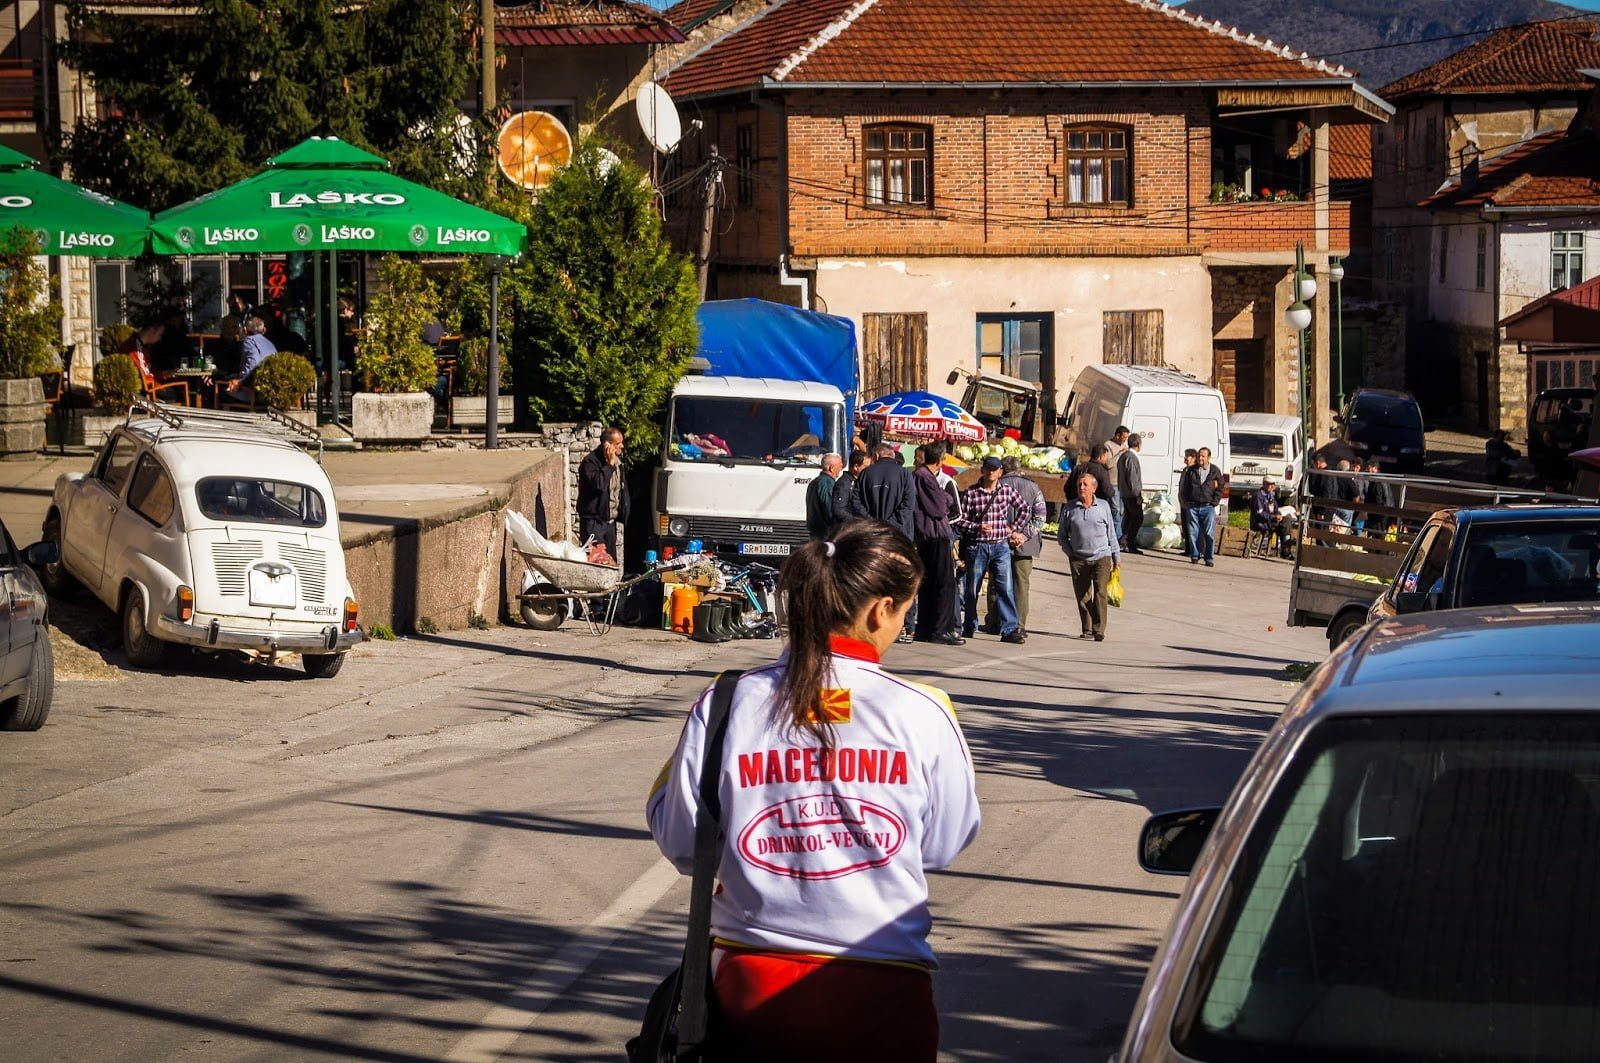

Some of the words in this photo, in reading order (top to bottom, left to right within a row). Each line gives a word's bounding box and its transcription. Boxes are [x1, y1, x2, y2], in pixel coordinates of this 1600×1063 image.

[270, 190, 405, 208] LAŠKO
[59, 230, 115, 249] LAŠKO
[204, 227, 259, 245] LAŠKO
[321, 225, 375, 243] LAŠKO
[437, 226, 491, 244] LAŠKO
[890, 419, 939, 431] Frikom
[945, 421, 979, 439] Frikom
[738, 748, 908, 788] MACEDONIA
[798, 801, 848, 819] K.U.D.
